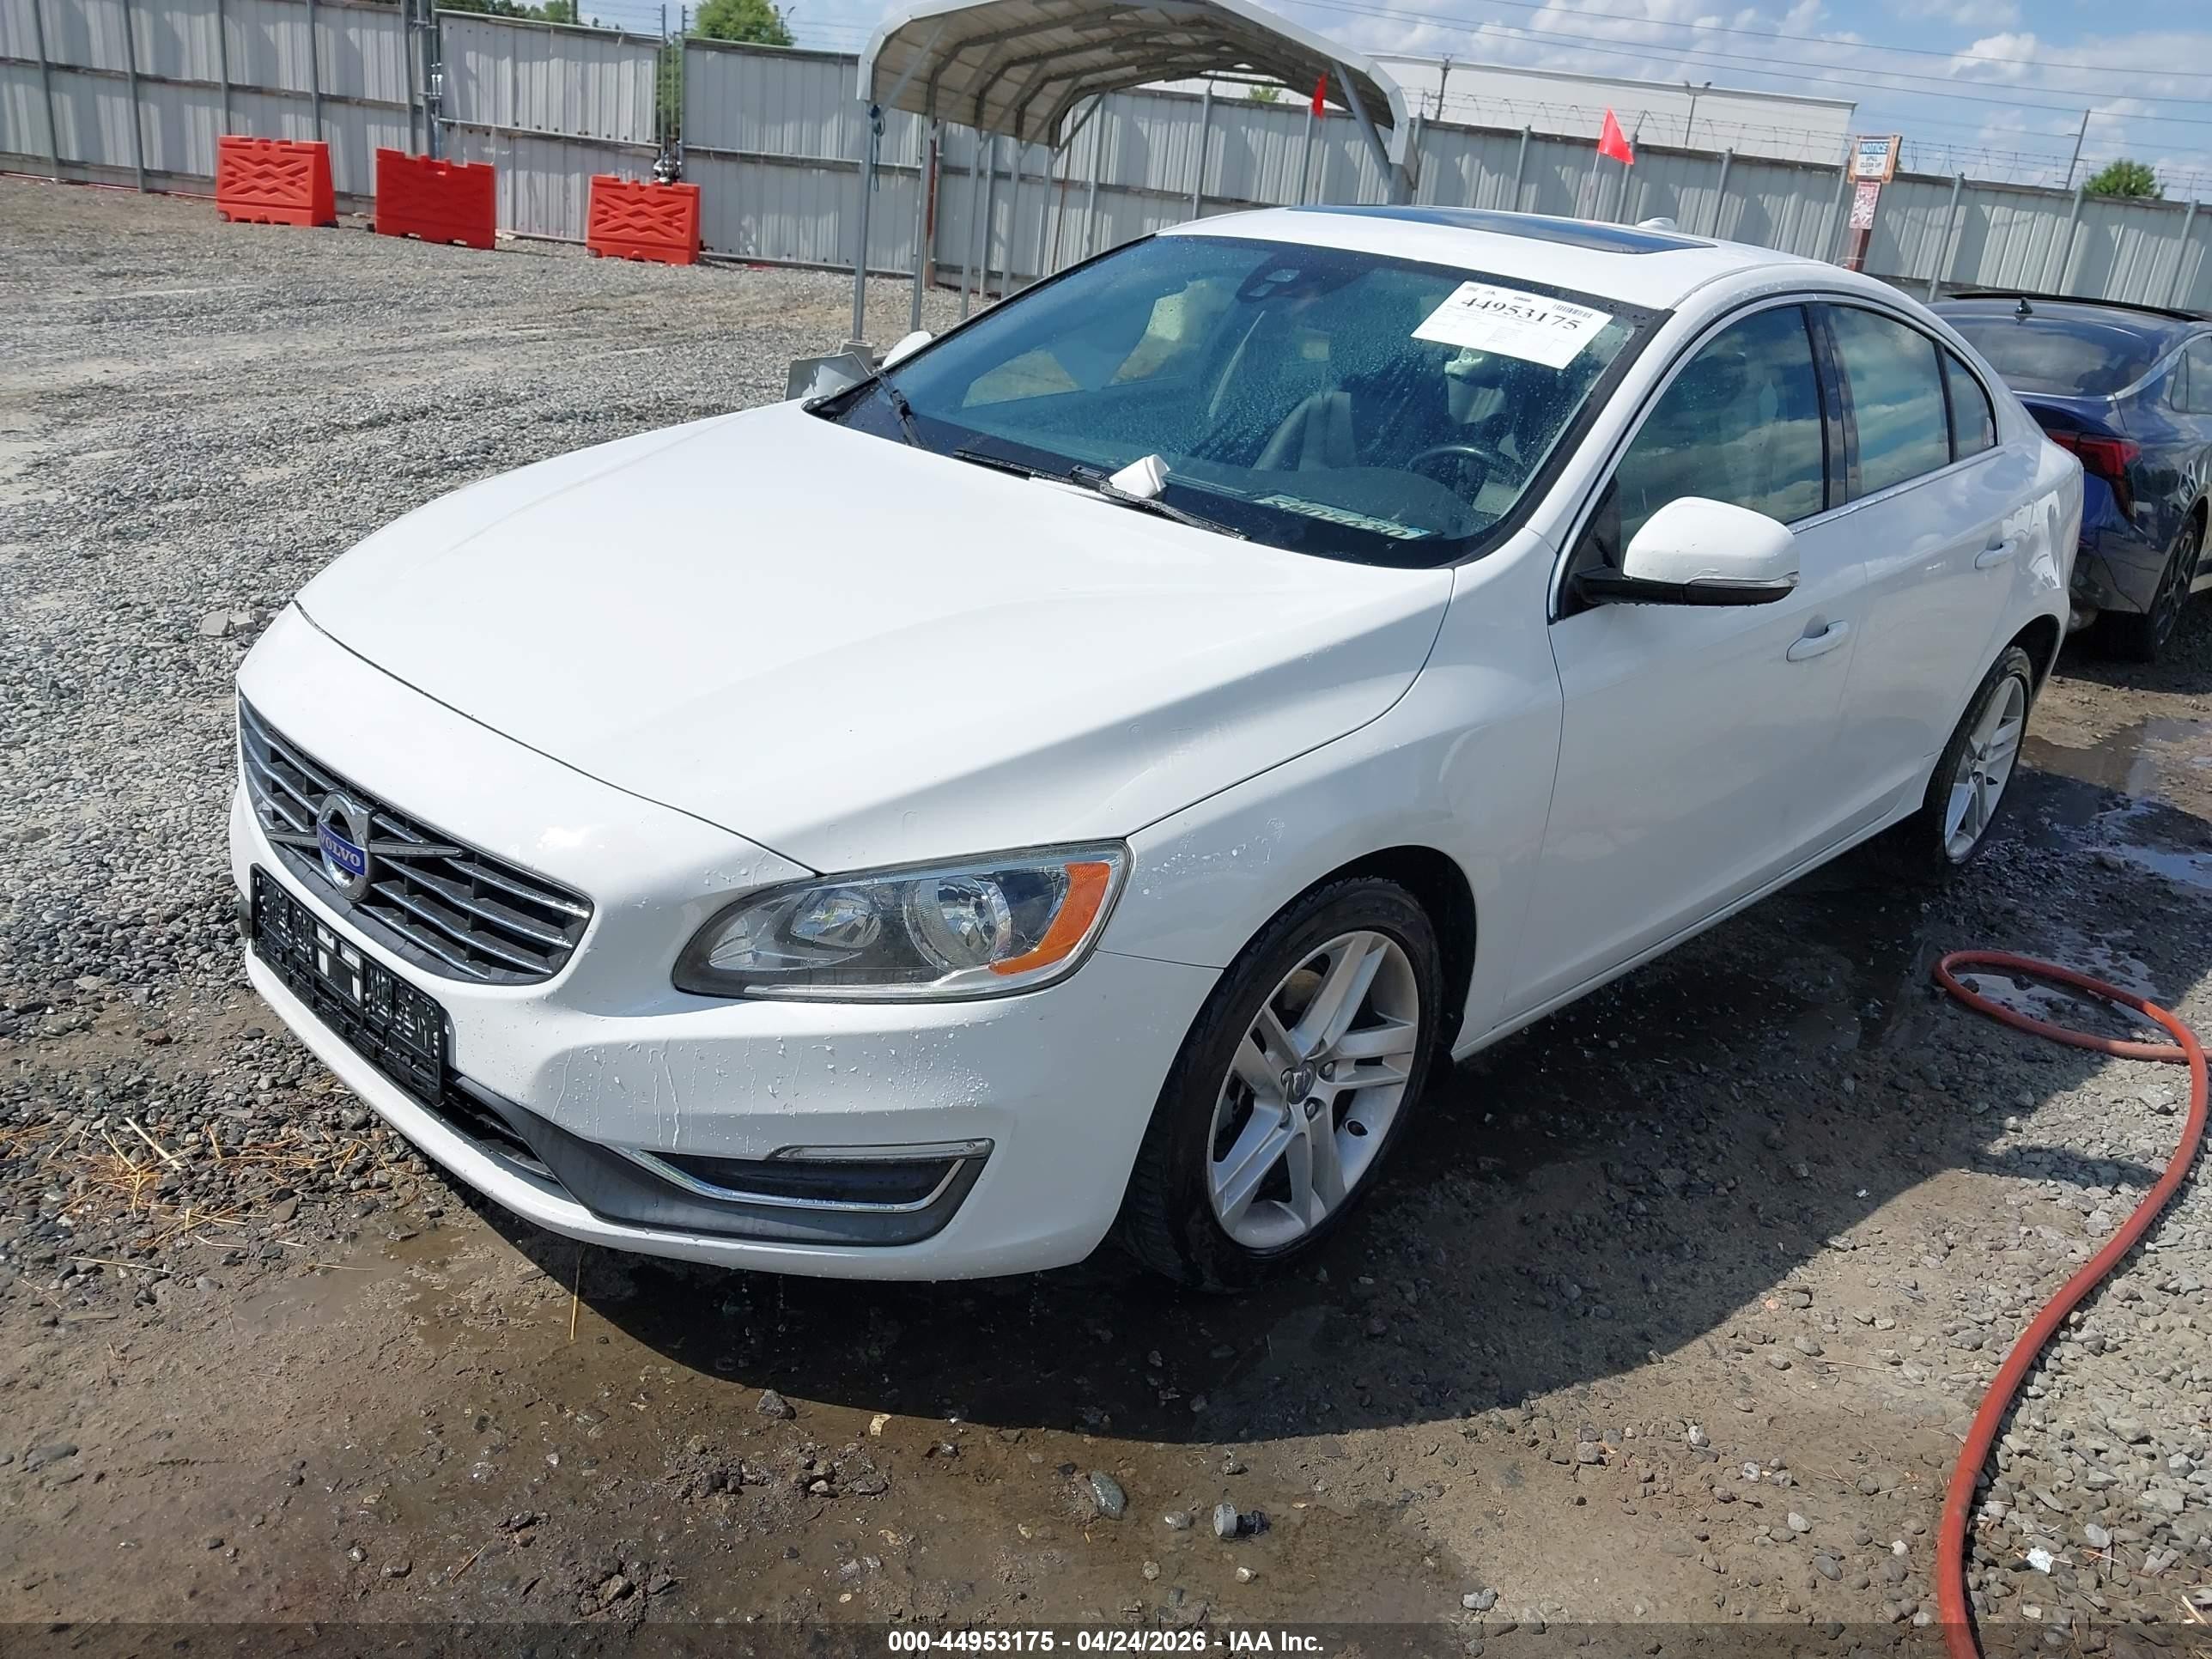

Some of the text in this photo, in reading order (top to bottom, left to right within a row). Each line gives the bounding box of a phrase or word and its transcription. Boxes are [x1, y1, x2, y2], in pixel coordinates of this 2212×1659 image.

[1860, 143, 1888, 153] NOTICE
[1461, 297, 1582, 331] 44953175
[319, 830, 361, 867] VOLVO
